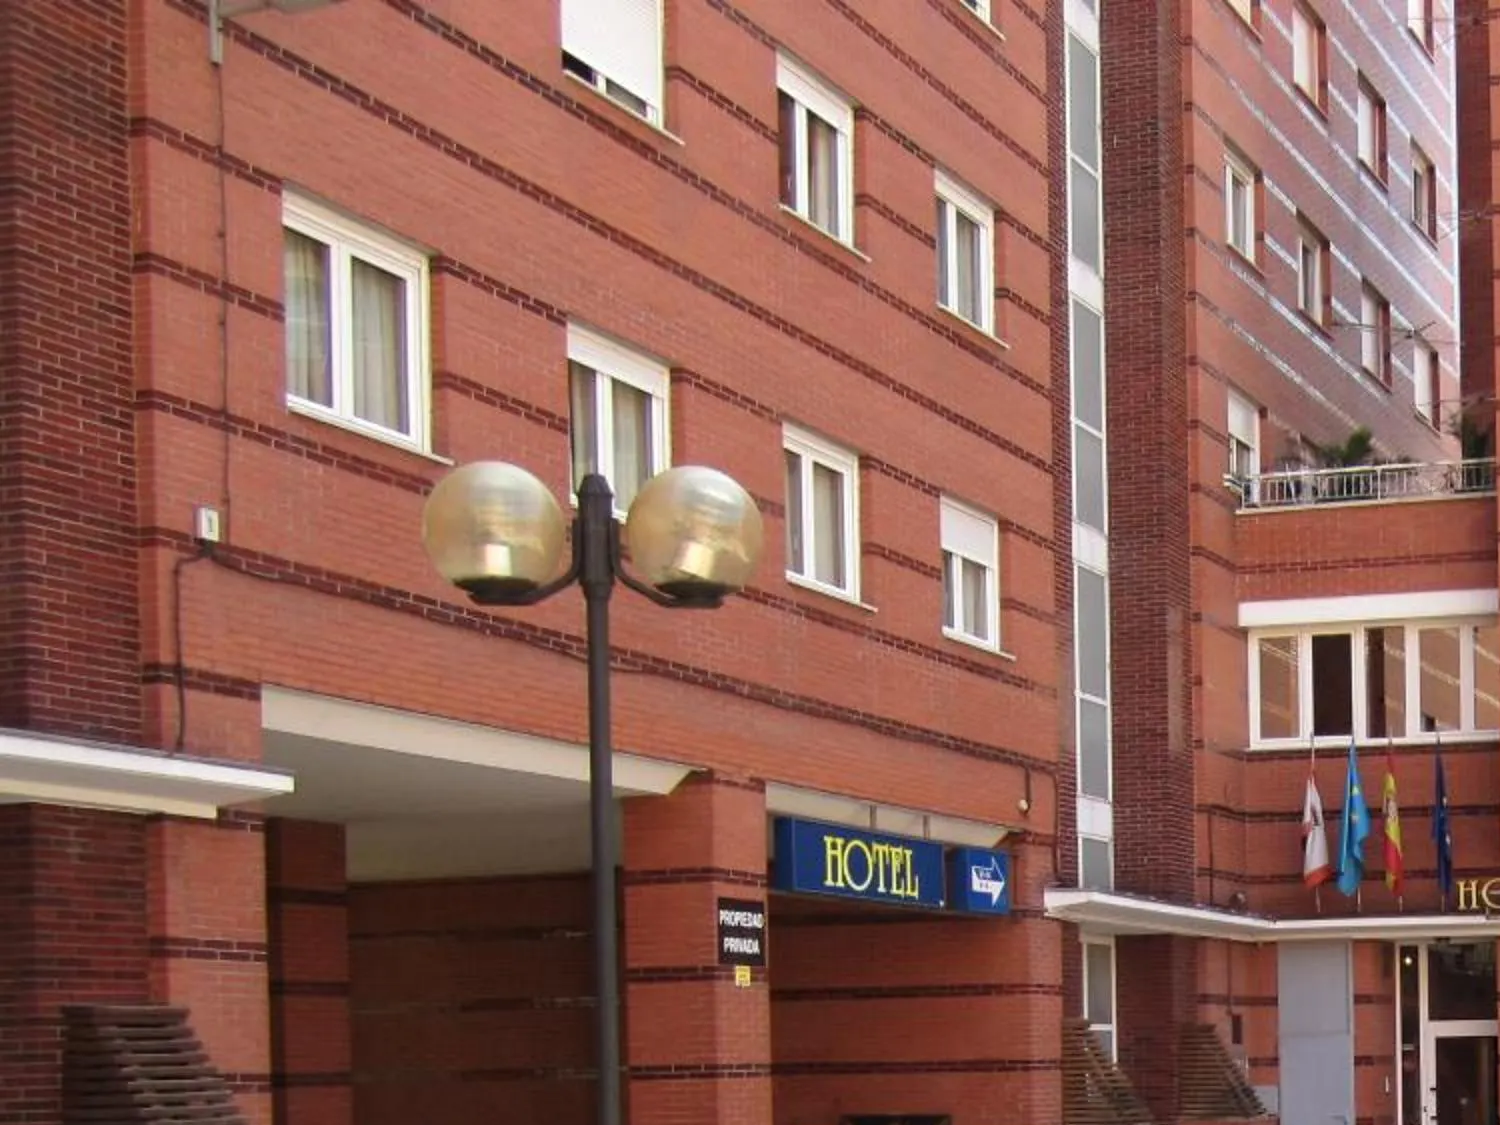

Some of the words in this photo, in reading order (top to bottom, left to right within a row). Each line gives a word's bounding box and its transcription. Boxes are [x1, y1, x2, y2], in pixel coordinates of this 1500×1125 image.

[823, 835, 919, 899] HOTEL
[719, 909, 765, 928] PROPIEDAD
[723, 937, 760, 954] PRIVADA
